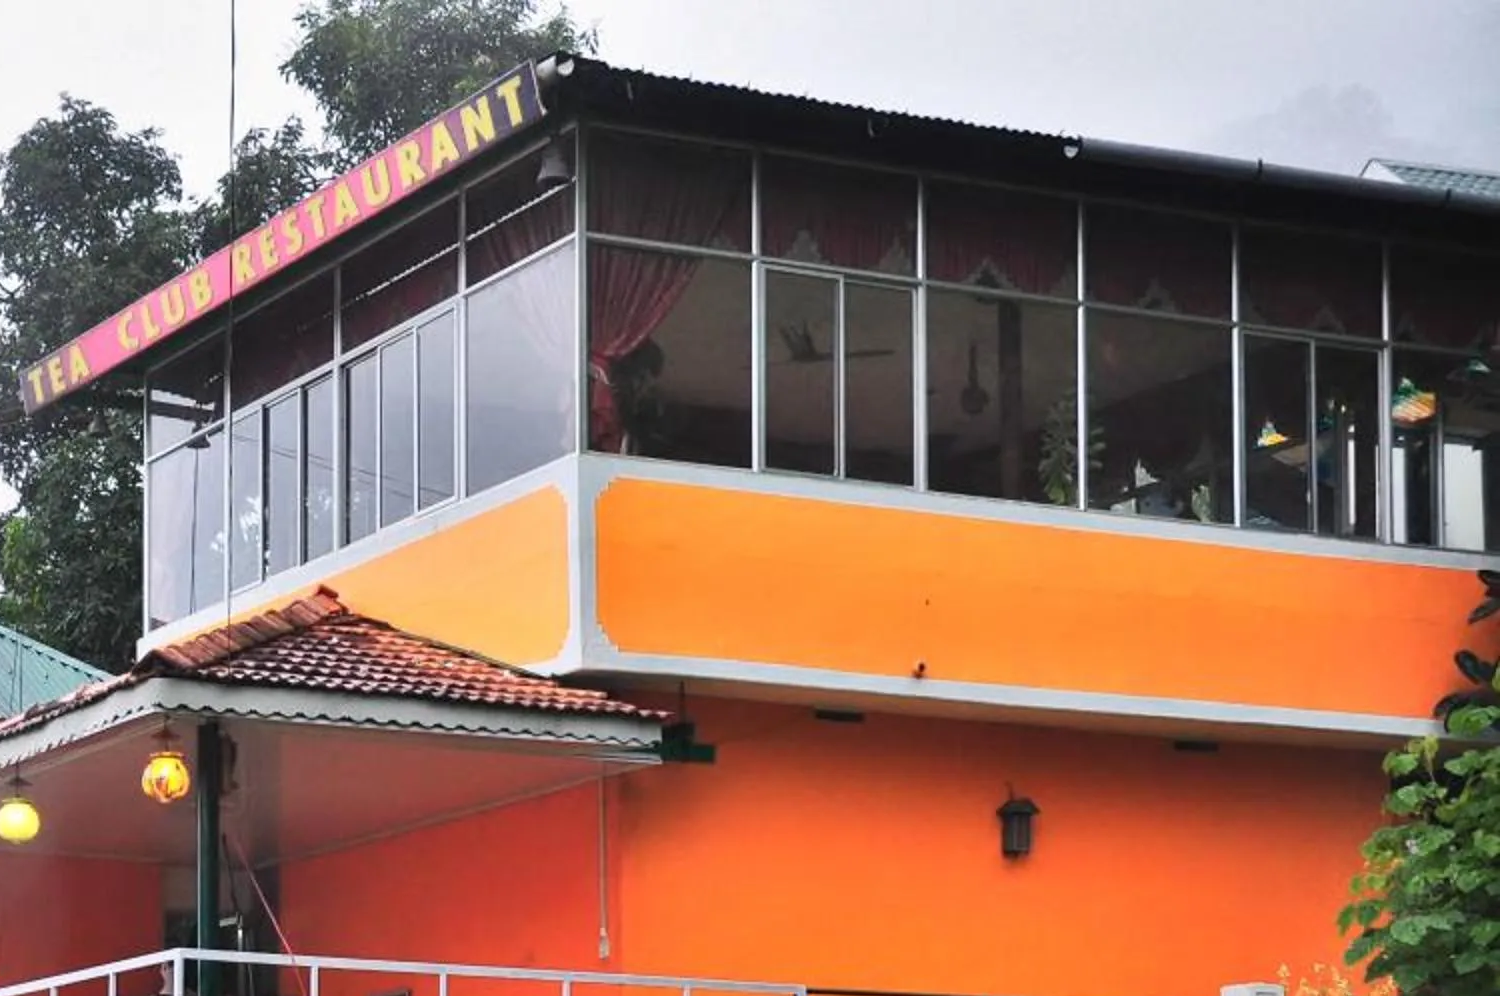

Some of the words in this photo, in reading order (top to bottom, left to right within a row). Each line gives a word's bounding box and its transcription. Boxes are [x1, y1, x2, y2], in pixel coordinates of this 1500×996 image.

[27, 345, 90, 405] TEA
[116, 271, 214, 353] CLUB
[230, 75, 524, 288] RESTAURANT
